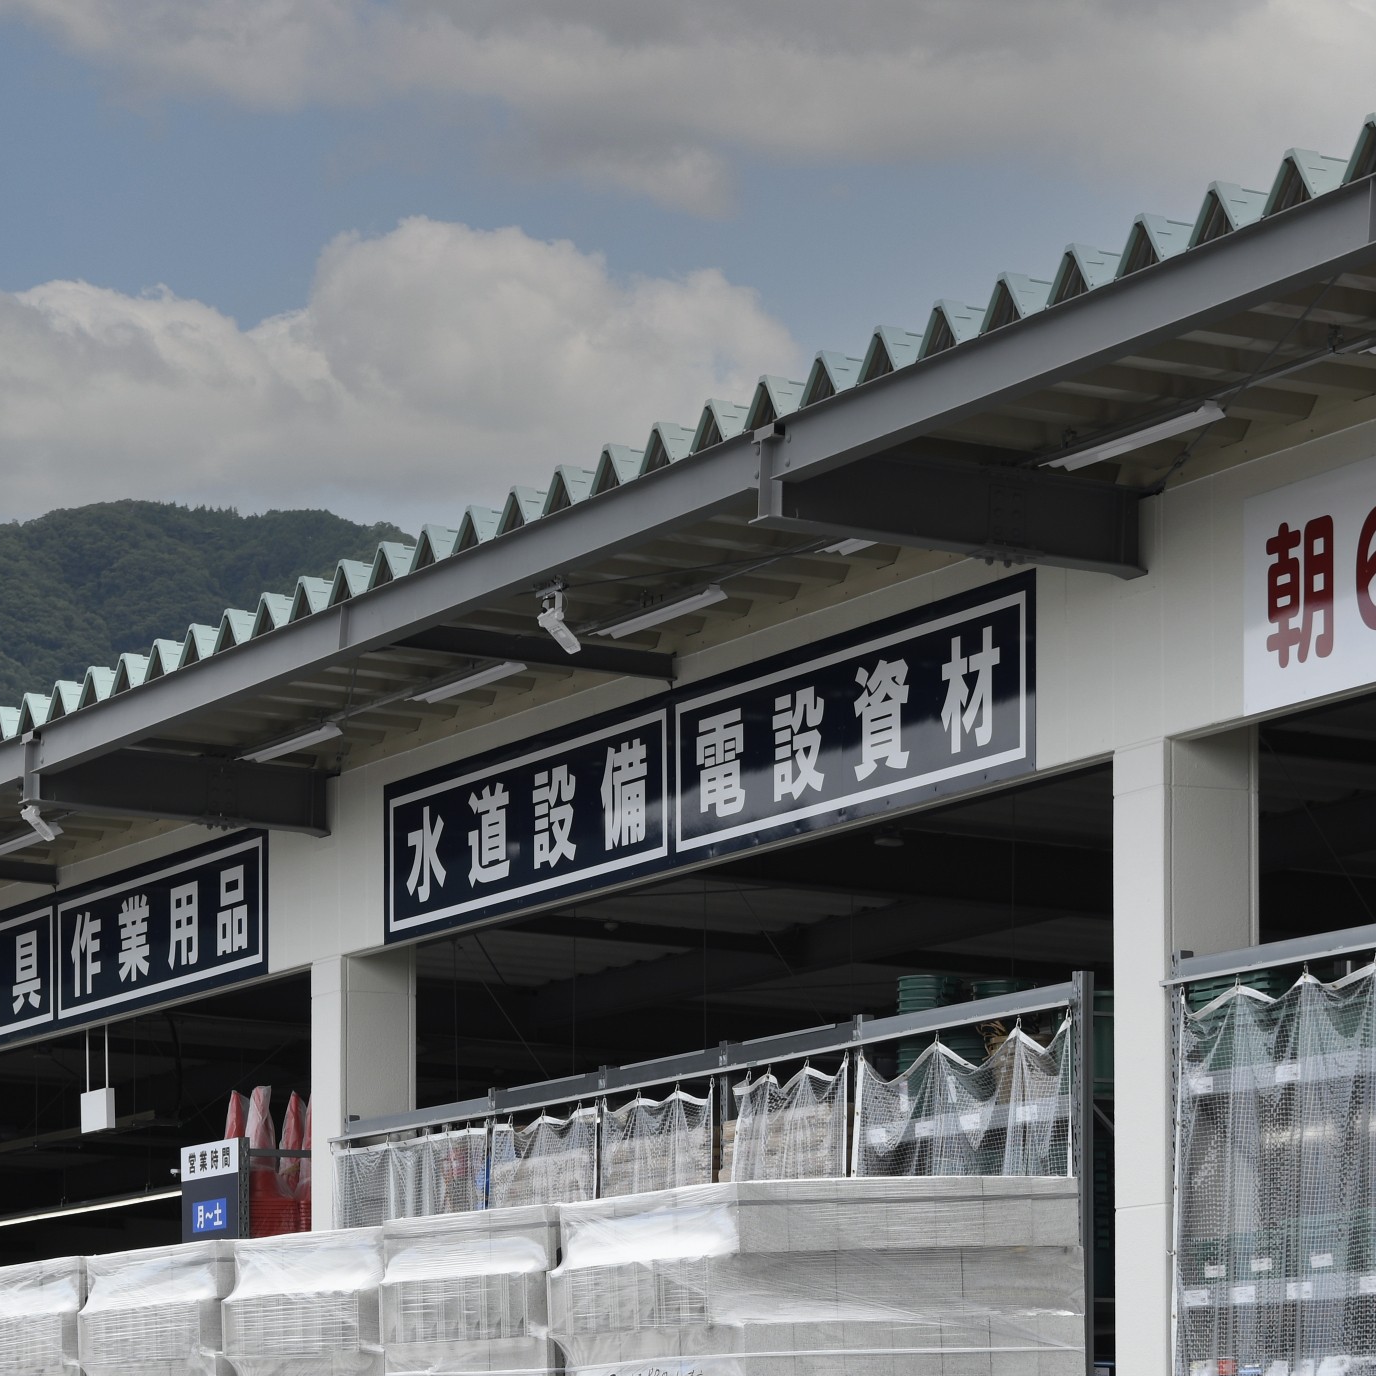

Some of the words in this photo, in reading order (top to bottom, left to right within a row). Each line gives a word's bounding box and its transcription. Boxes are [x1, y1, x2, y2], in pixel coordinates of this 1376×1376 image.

[696, 625, 1001, 818] 電設資材
[406, 738, 648, 903] 水道設備
[71, 863, 248, 998] 作業用品
[188, 1146, 231, 1174] 営業時間
